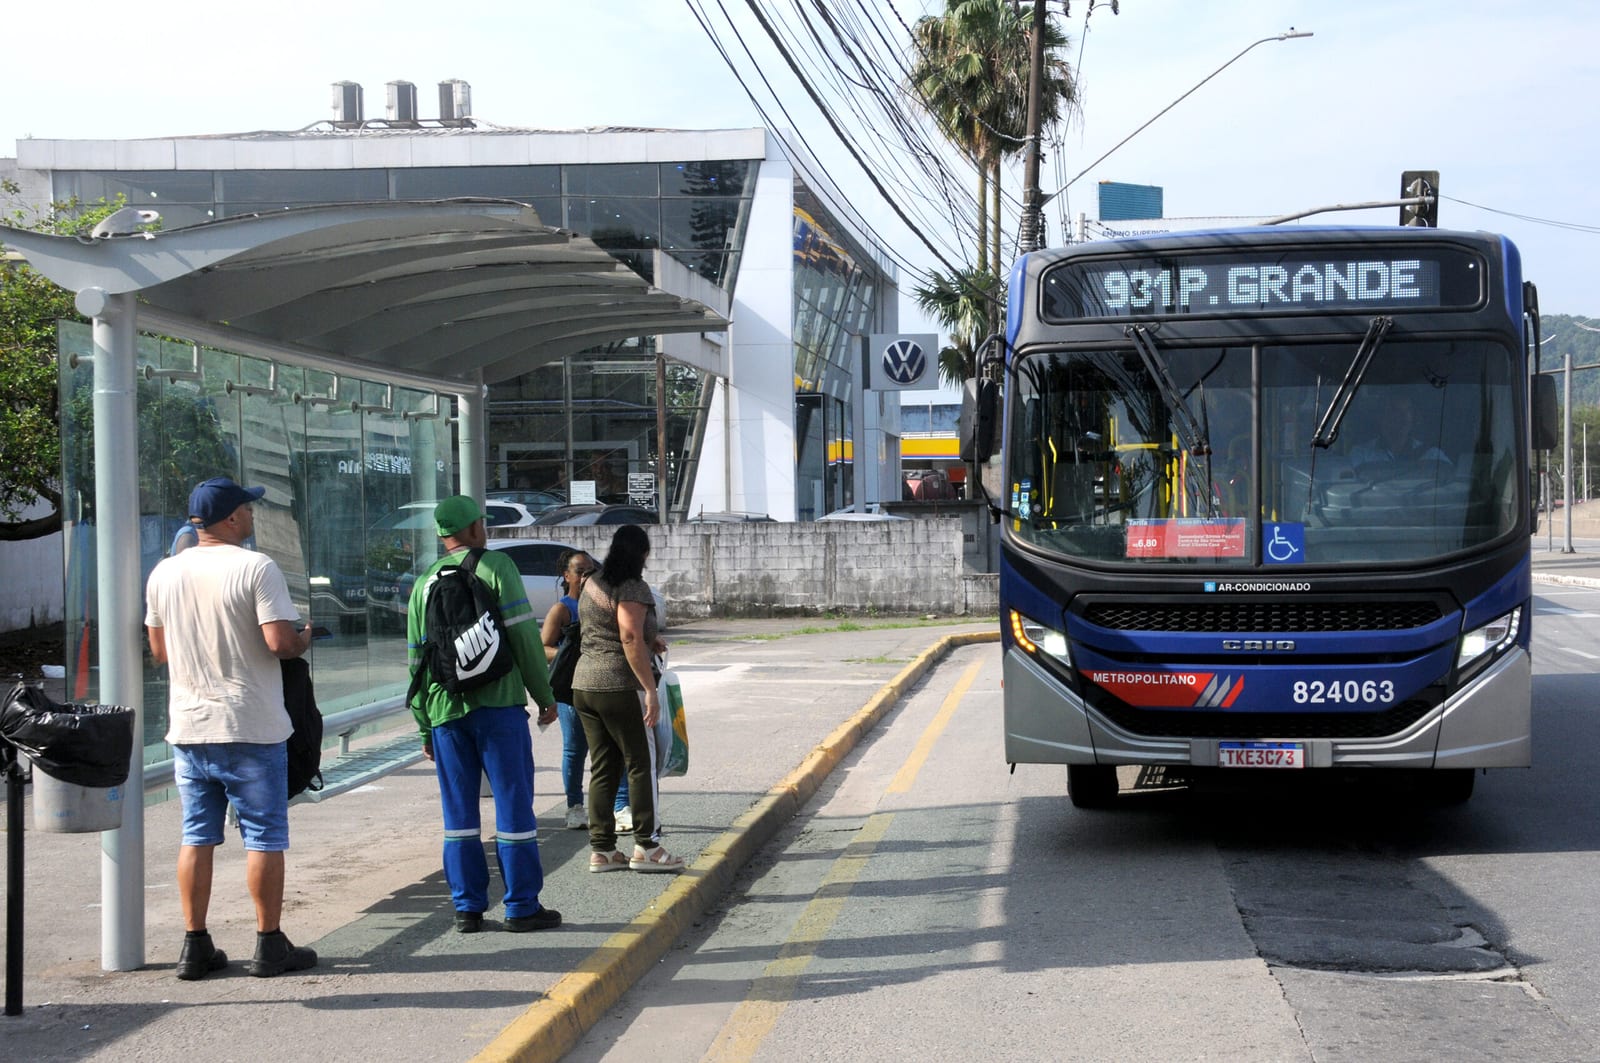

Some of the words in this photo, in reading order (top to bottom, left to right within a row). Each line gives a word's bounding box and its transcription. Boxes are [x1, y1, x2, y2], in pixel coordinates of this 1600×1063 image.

[1104, 270, 1172, 308] 931
[1180, 268, 1219, 306] P.
[1228, 260, 1420, 304] GRANDE
[884, 340, 925, 381] VW
[1218, 582, 1311, 592] AR-CONDICIONADO
[454, 611, 498, 668] NIKE
[1092, 672, 1197, 686] METROPOLITANO
[1293, 680, 1395, 704] 824063
[1226, 750, 1295, 766] TKE3C73
